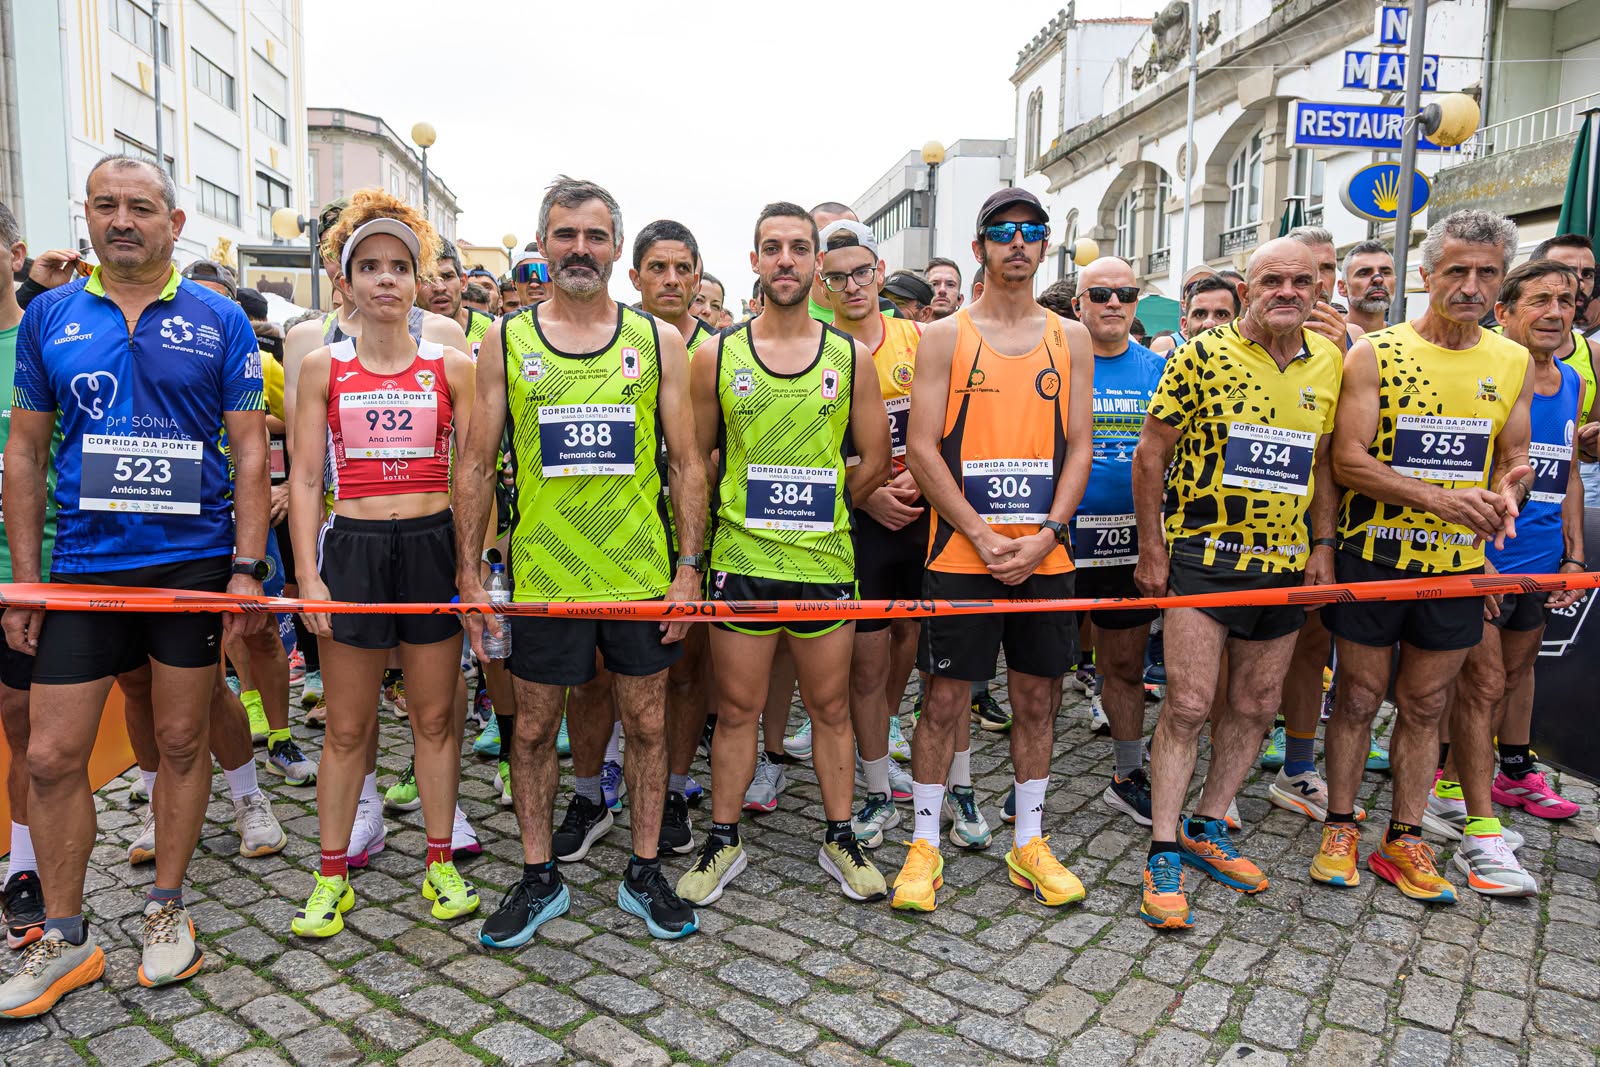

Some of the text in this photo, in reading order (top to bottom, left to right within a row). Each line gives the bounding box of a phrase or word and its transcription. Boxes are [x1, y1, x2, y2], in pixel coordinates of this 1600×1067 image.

[1300, 109, 1424, 141] RESTAUR
[54, 333, 93, 345] LUSOSPORT
[162, 343, 214, 358] RUNNING TEAM
[886, 397, 910, 407] PONTE
[1093, 398, 1102, 412] DA
[1103, 398, 1113, 412] DA
[1114, 399, 1138, 412] PONTE
[542, 407, 583, 416] CORRIDA
[602, 406, 631, 414] PONTE
[132, 414, 179, 429] SÓNIA
[366, 409, 413, 431] 932
[1402, 416, 1442, 425] CORRIDA
[564, 423, 612, 447] 388
[1233, 424, 1270, 434] CORRIDA
[1286, 431, 1312, 441] PONTE
[88, 437, 197, 451] CORRIDA DA PONTE
[1421, 432, 1466, 456] 955
[598, 450, 616, 458] Grilo
[1250, 442, 1291, 467] 954
[1406, 456, 1472, 467] Joaquim Miranda
[113, 457, 172, 483] 523
[1234, 464, 1299, 480] Joaquim Rodrigues
[110, 485, 172, 496] António Silva
[769, 482, 813, 505] 384
[987, 476, 1032, 498] 306
[777, 508, 816, 516] Gonçalves
[1096, 528, 1131, 546] 703
[1366, 524, 1437, 544] TRILHOS
[1094, 548, 1112, 556] Sérgio
[1204, 536, 1271, 556] TRILHOS
[1416, 589, 1442, 598] LUZIA
[89, 600, 126, 608] LUZIA
[566, 606, 640, 615] TRAIL SANTA
[795, 602, 862, 611] TRAIL SANTA
[1392, 823, 1412, 832] CAT
